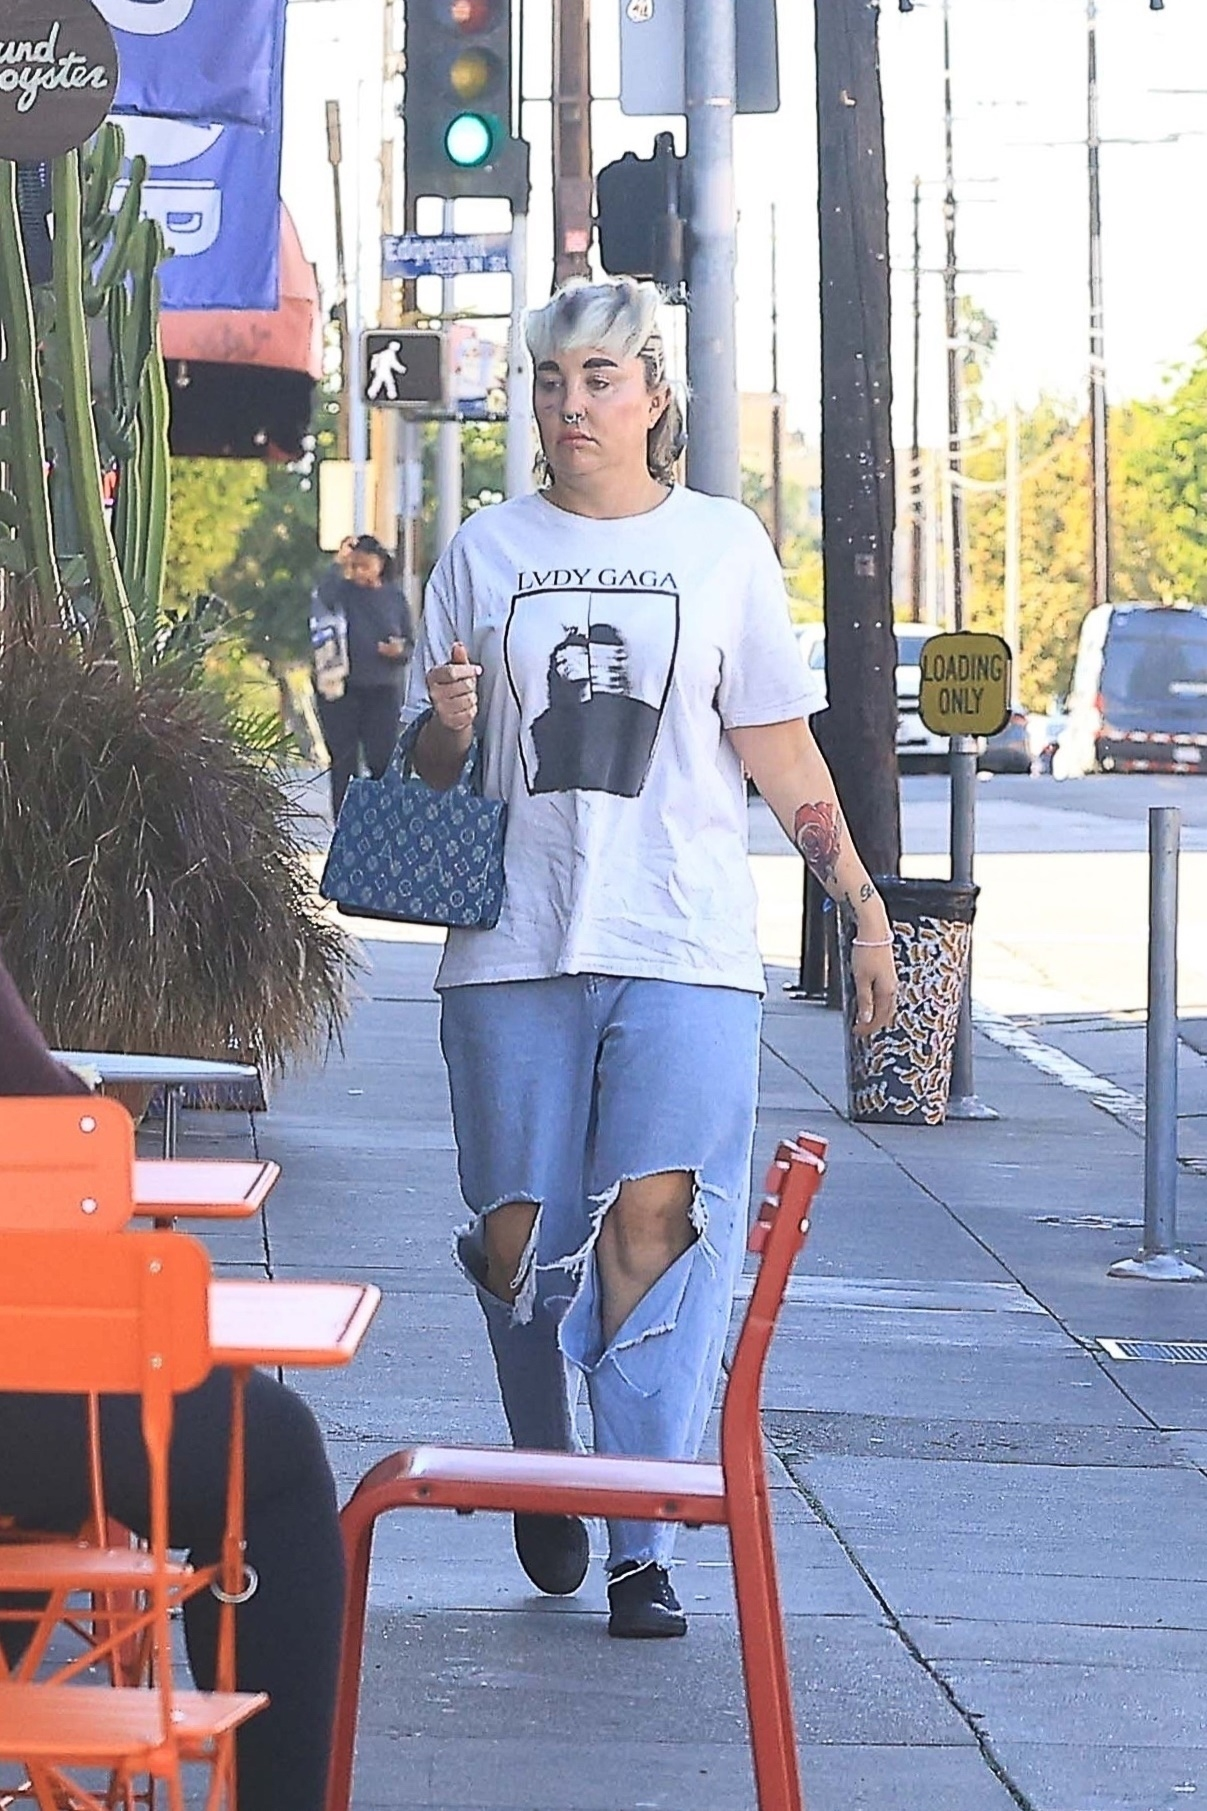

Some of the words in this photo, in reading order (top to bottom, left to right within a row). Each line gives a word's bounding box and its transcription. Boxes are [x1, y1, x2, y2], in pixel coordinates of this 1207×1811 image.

[597, 568, 677, 589] GAGA
[922, 654, 1003, 682] LOADING
[939, 687, 985, 715] ONLY
